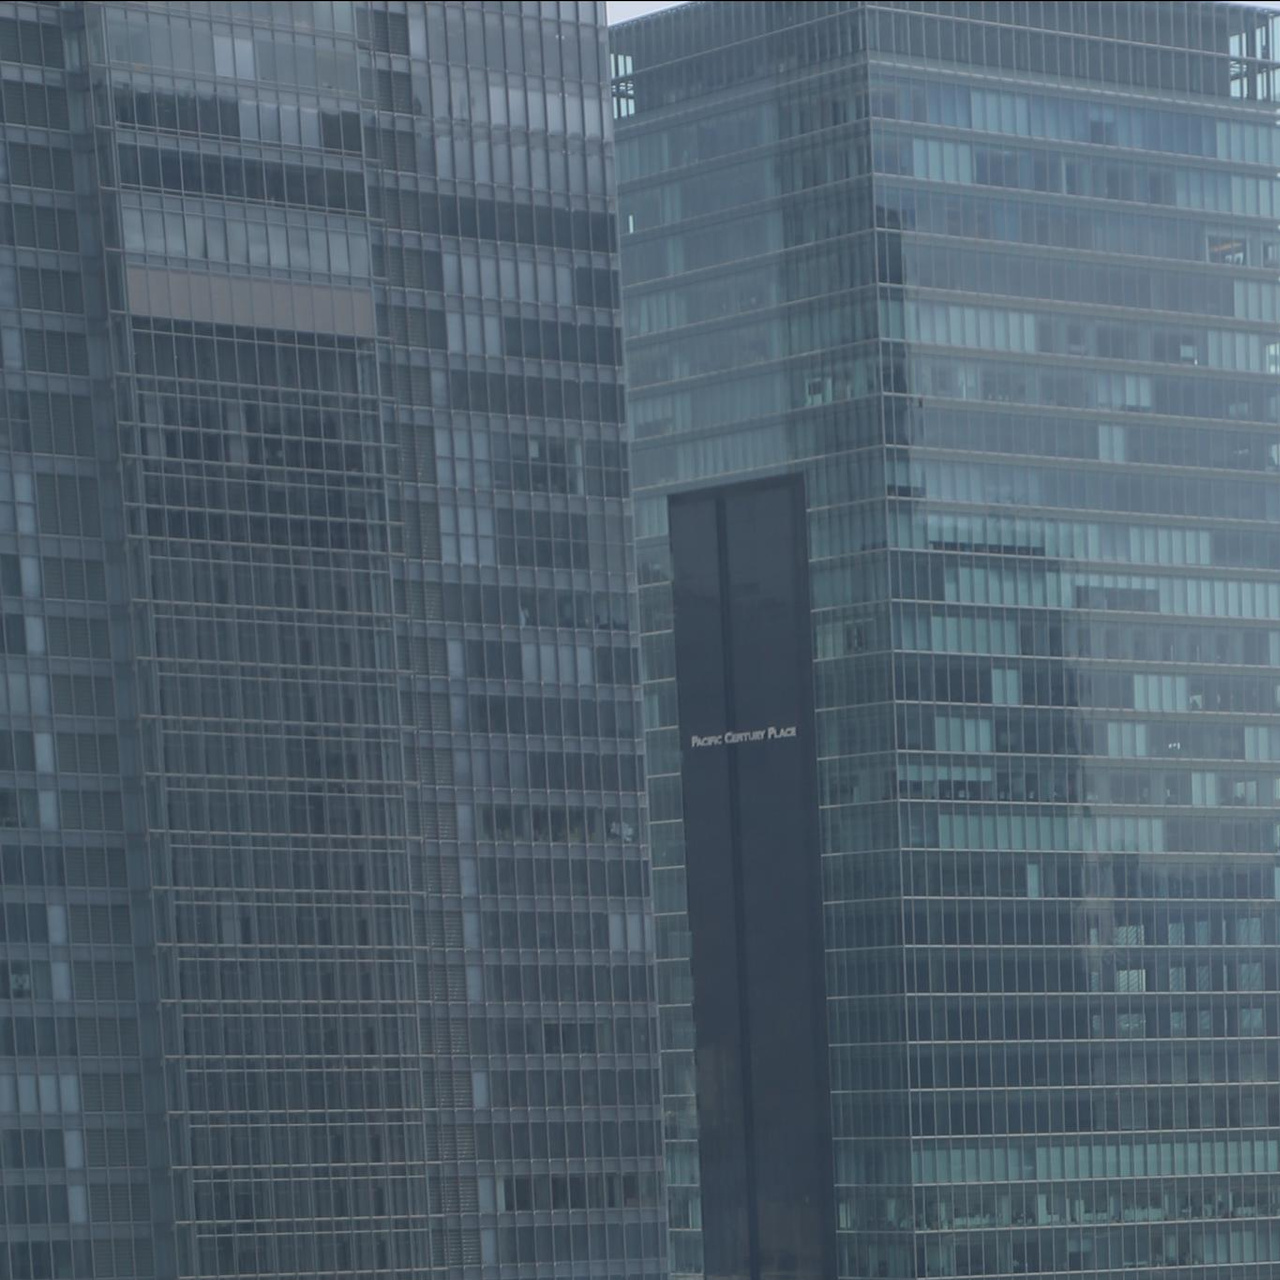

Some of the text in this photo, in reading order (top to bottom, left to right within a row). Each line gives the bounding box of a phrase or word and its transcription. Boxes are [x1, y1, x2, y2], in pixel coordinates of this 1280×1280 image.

[691, 726, 797, 748] PACIFIC CENTURY PLACE
